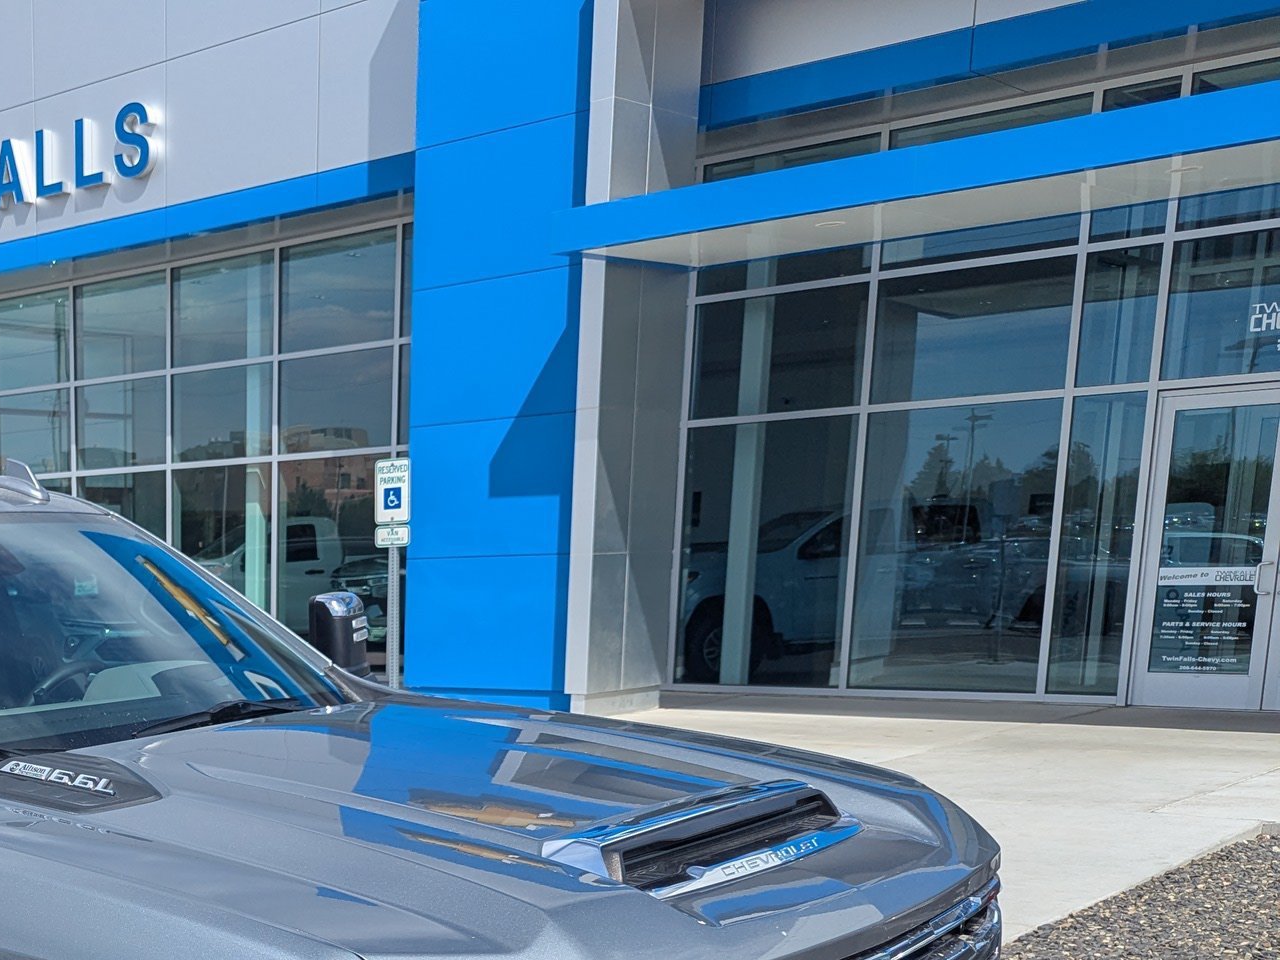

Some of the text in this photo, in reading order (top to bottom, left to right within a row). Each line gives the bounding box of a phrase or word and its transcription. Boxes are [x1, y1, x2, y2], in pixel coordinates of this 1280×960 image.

[377, 464, 408, 475] RESERVED
[379, 475, 406, 485] PARKING
[1160, 573, 1198, 581] Welcome
[1161, 655, 1237, 664] TwinFalls-Chevy.com
[21, 763, 47, 774] Allison
[720, 836, 819, 878] CHEVROLET
